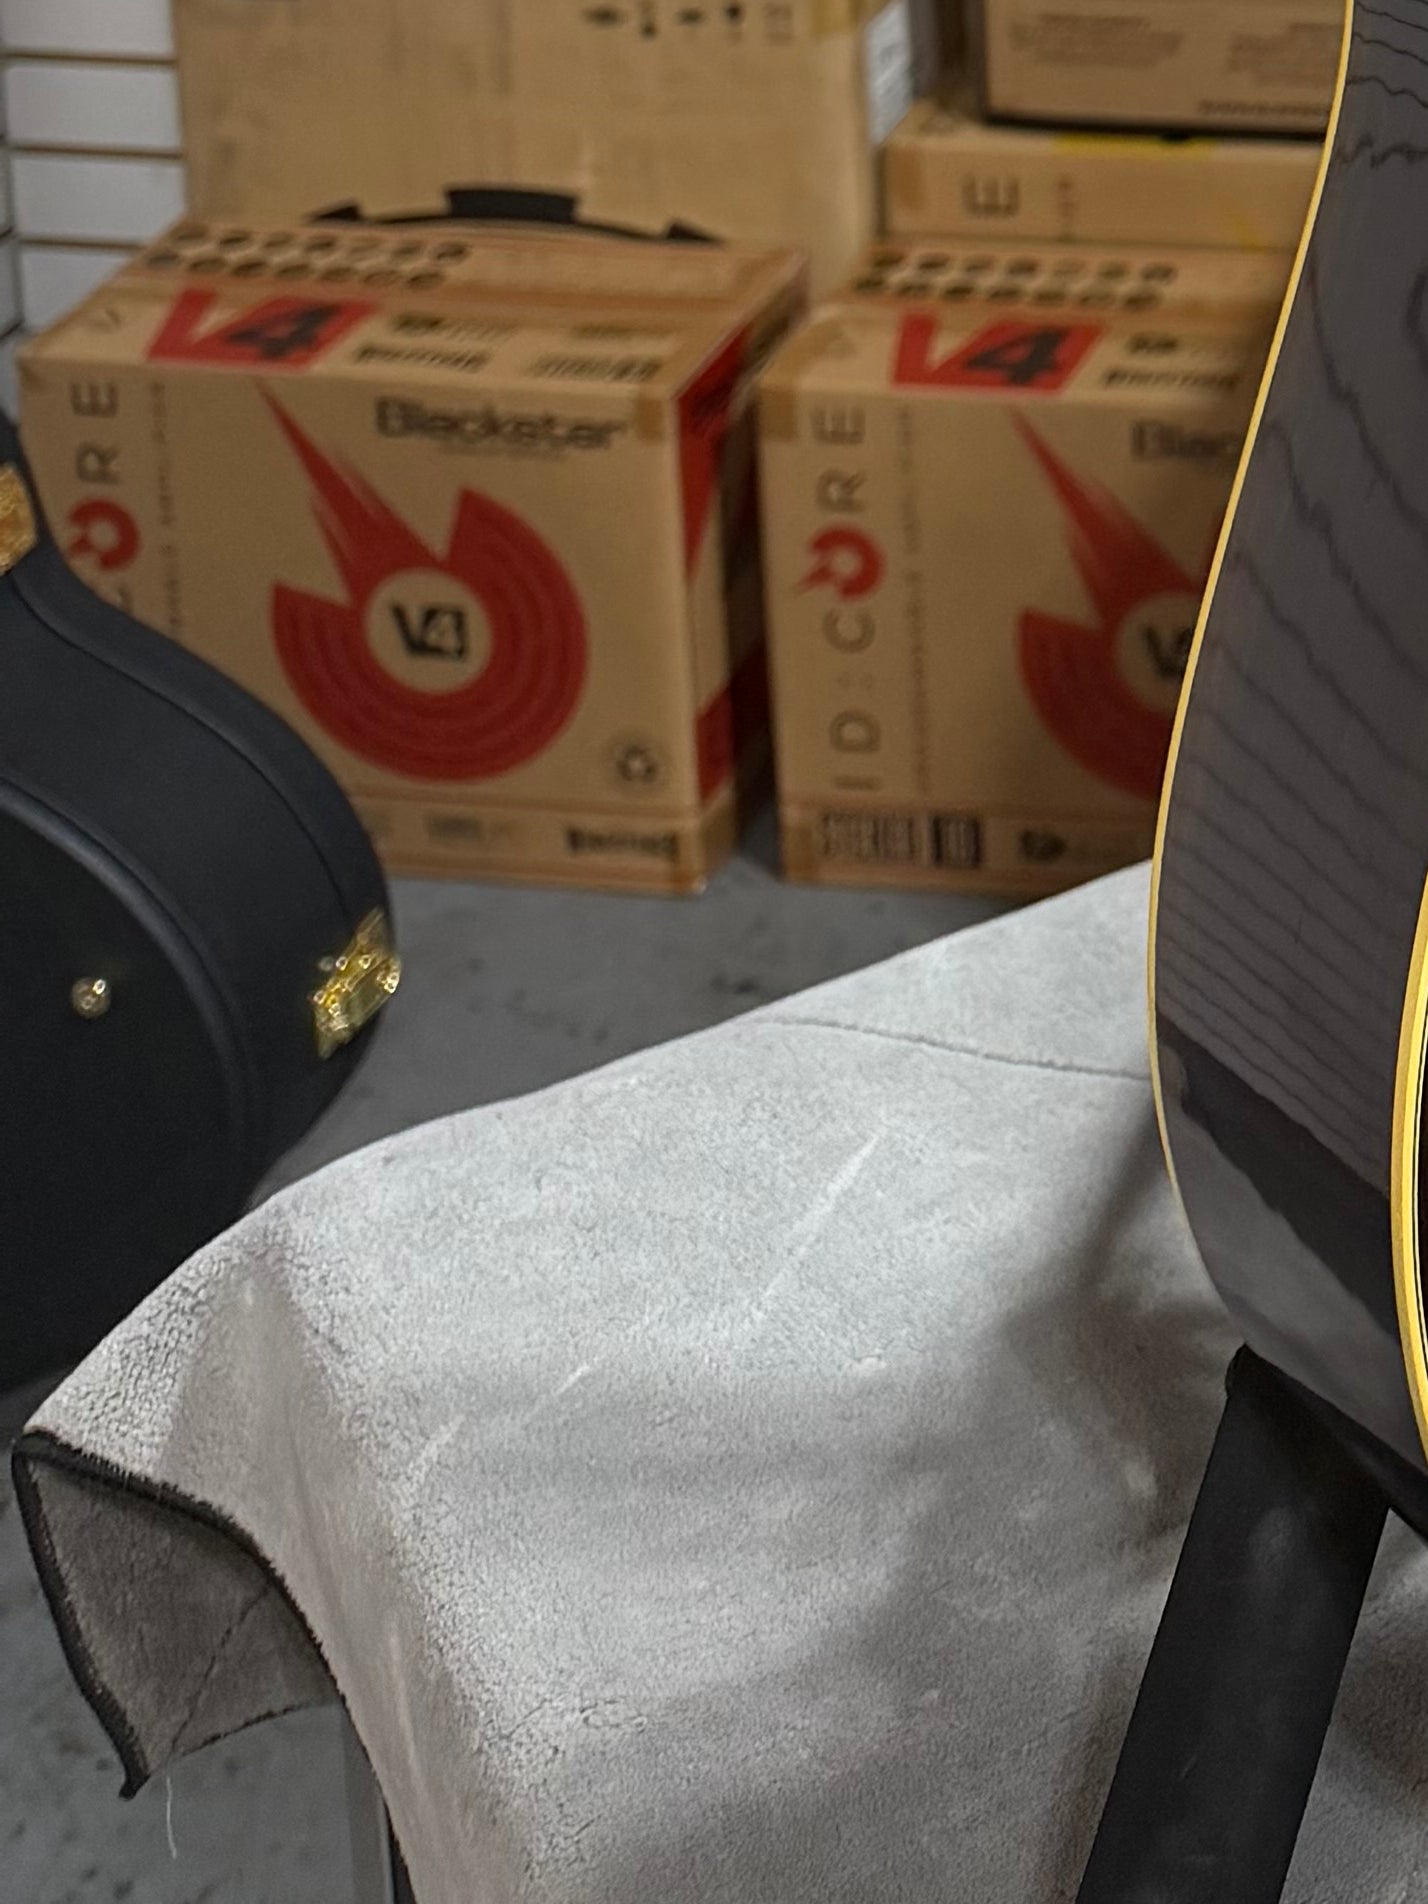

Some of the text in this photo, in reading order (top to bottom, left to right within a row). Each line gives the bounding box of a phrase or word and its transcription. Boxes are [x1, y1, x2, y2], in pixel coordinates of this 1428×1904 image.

[146, 288, 382, 375] V4
[892, 310, 1110, 396] V4
[375, 395, 628, 450] Blackstar
